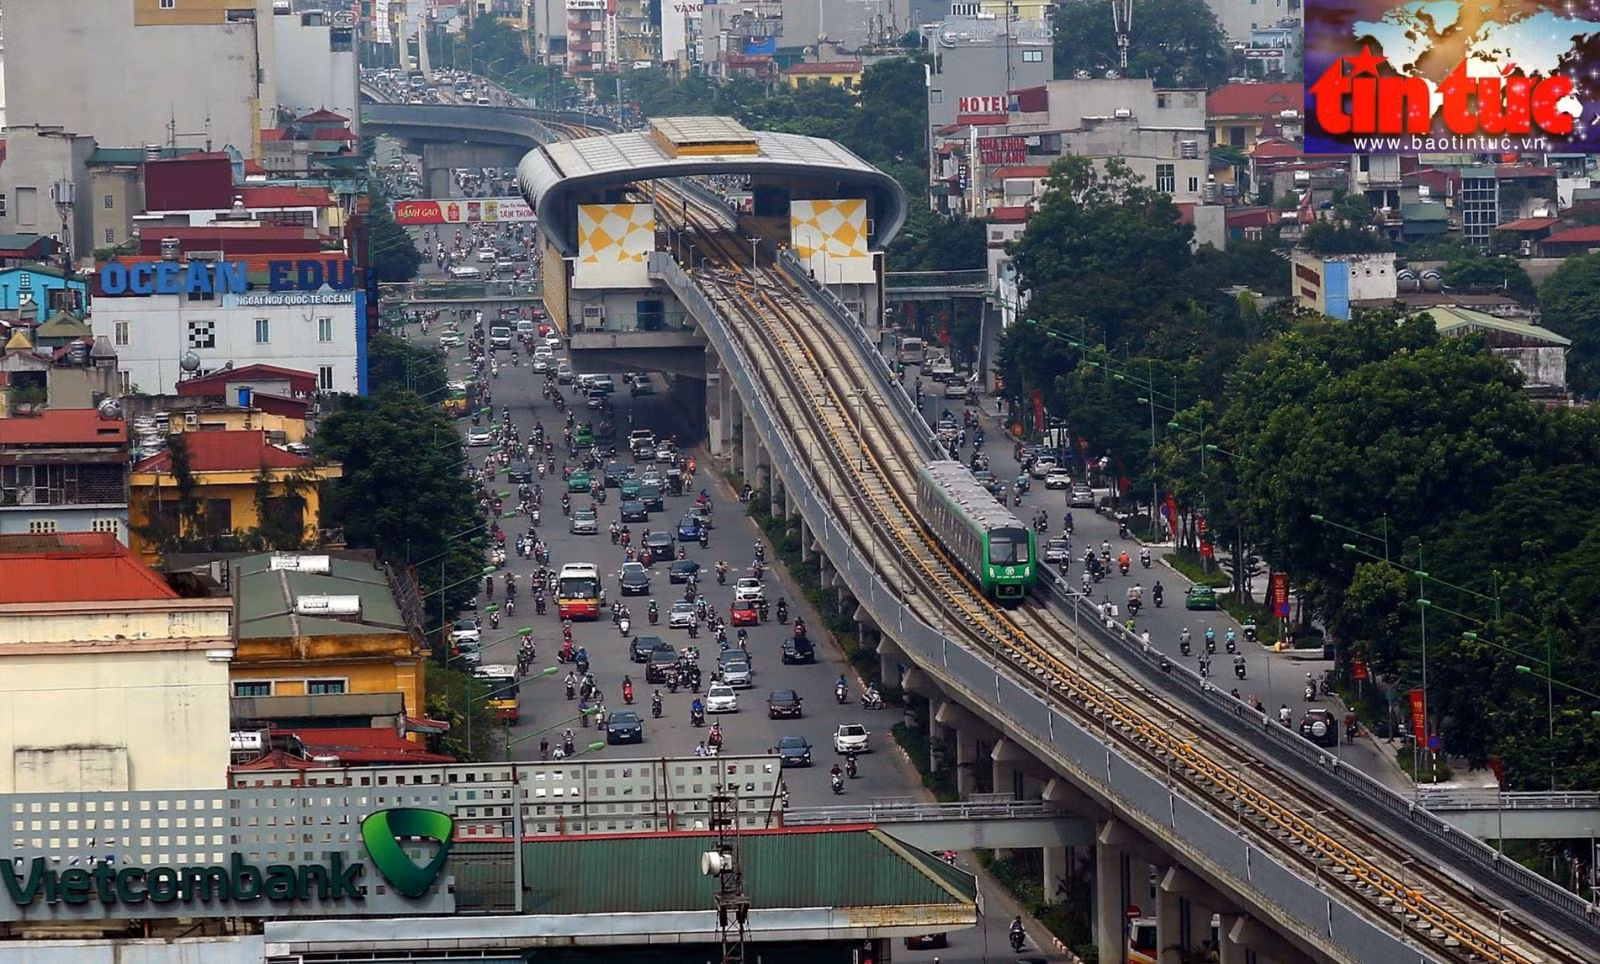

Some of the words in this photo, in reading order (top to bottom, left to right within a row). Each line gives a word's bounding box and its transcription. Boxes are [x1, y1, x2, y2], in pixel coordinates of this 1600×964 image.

[959, 96, 1008, 112] HOTEL
[100, 260, 247, 295] OCEAN
[268, 259, 353, 292] EDU
[322, 294, 351, 304] OCEAN
[0, 851, 364, 906] Vietcombank
